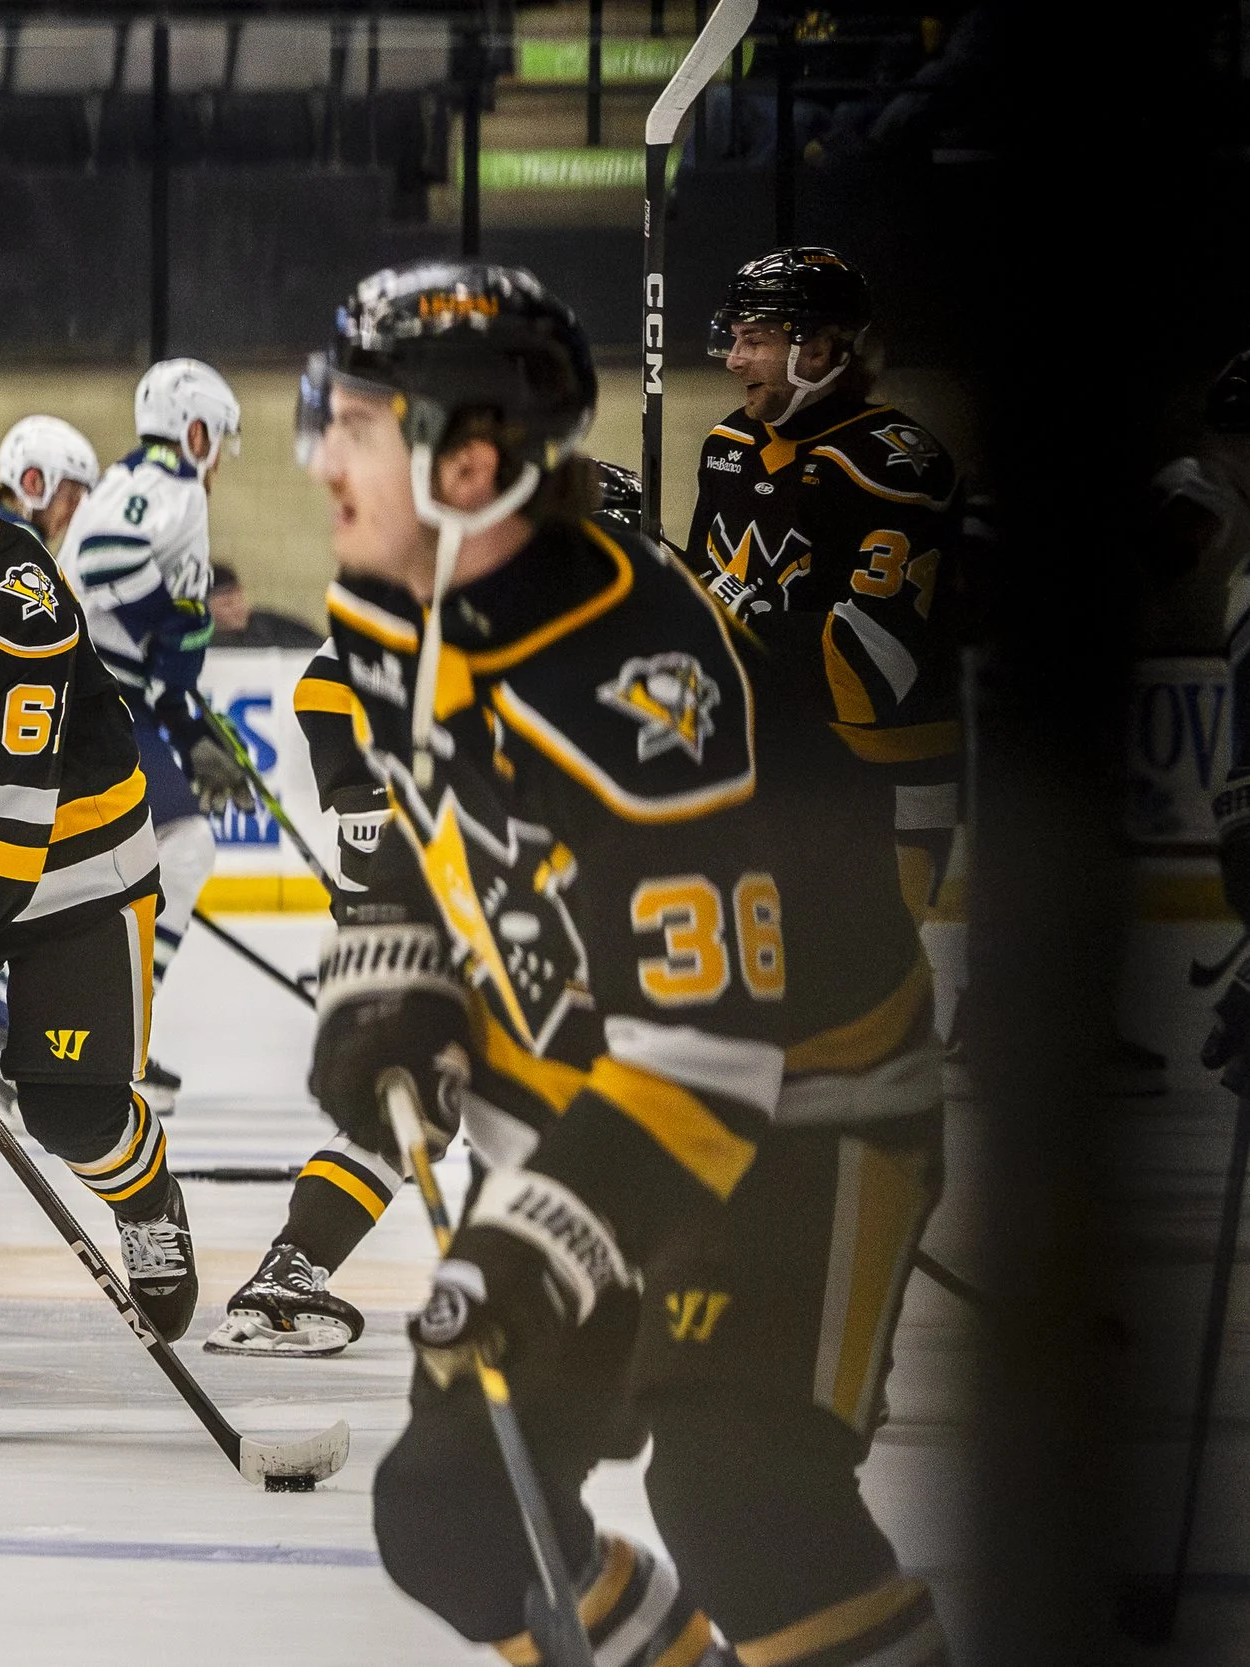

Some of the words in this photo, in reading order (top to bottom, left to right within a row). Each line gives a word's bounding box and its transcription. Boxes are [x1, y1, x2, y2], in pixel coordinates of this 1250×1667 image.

[646, 273, 664, 394] CCM
[125, 495, 148, 525] 8
[1, 682, 69, 755] 6
[71, 1240, 158, 1348] CCM
